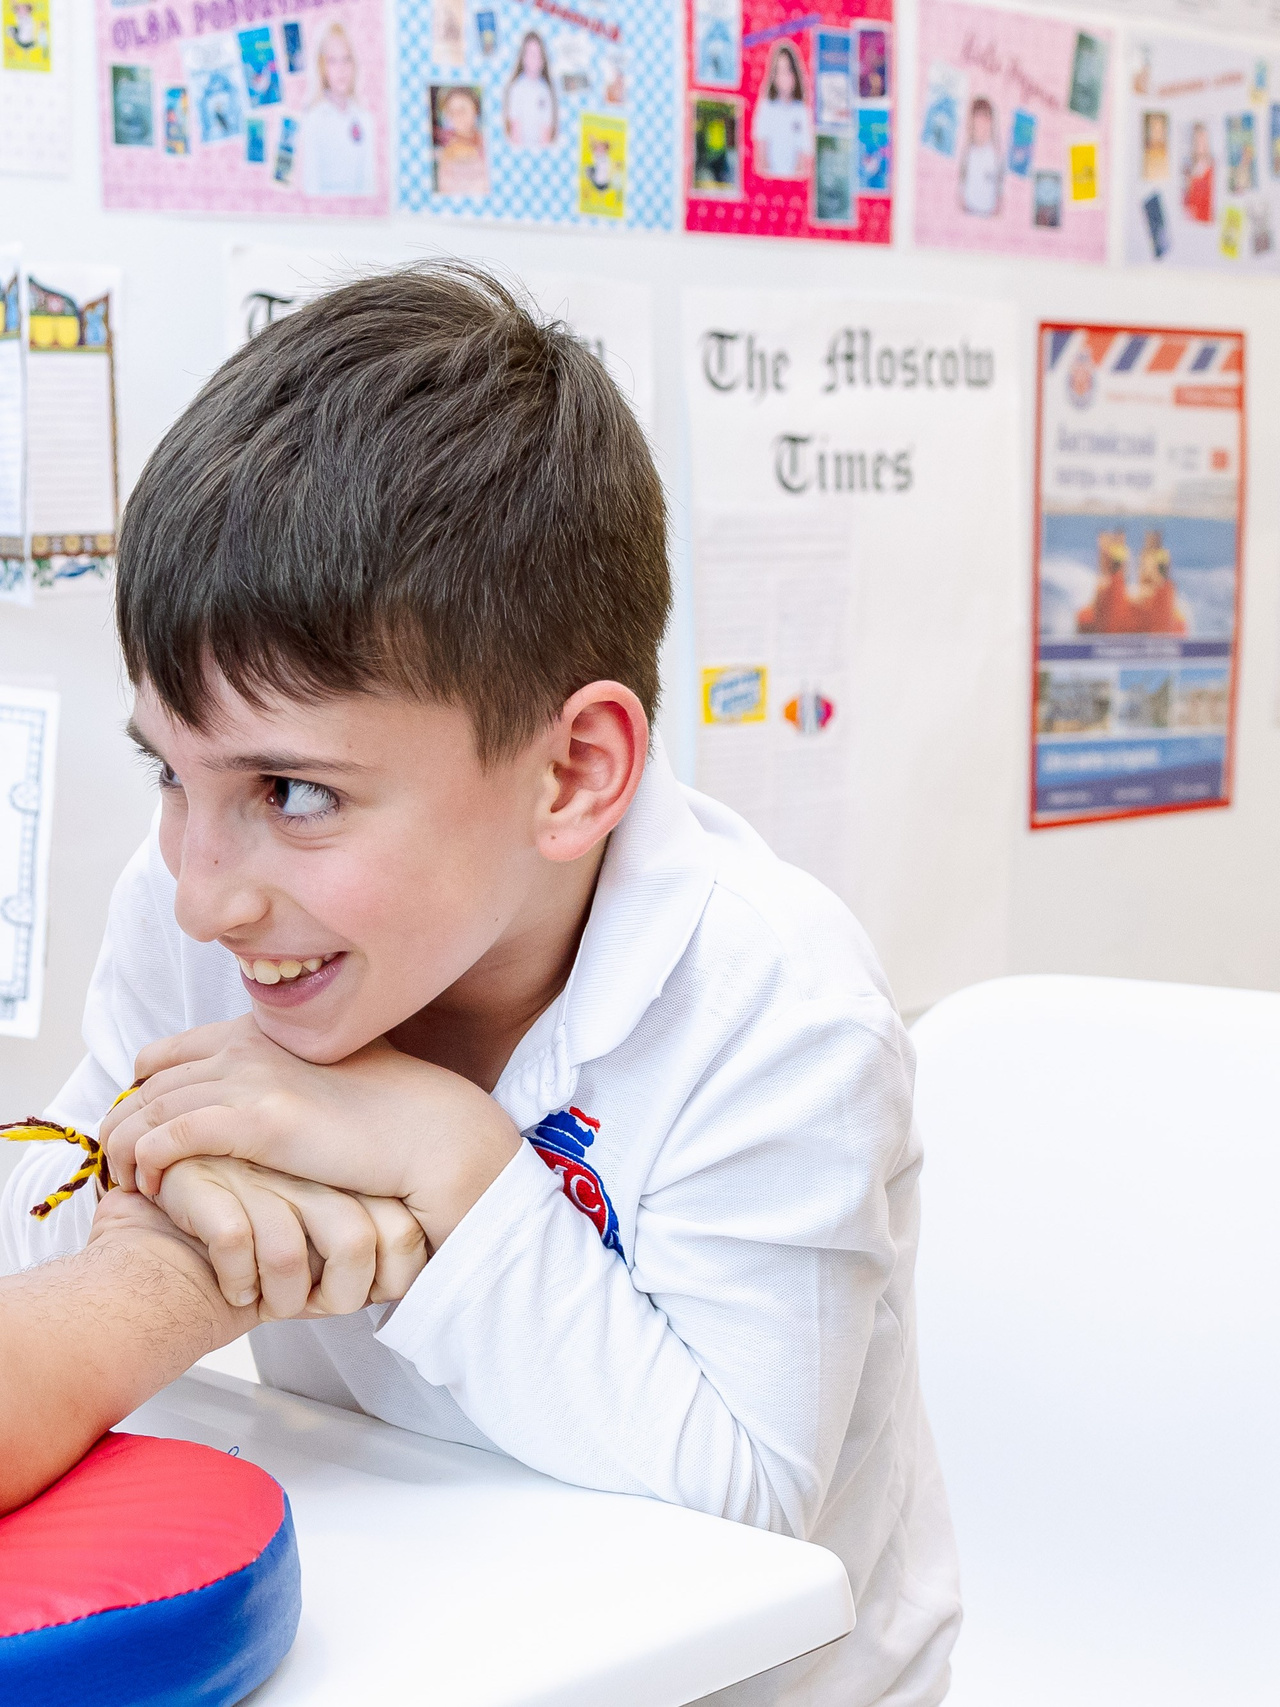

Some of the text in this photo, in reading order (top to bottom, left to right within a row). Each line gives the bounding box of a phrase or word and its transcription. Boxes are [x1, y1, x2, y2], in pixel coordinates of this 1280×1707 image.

[700, 326, 995, 404] The Moscow
[773, 431, 915, 494] Times
